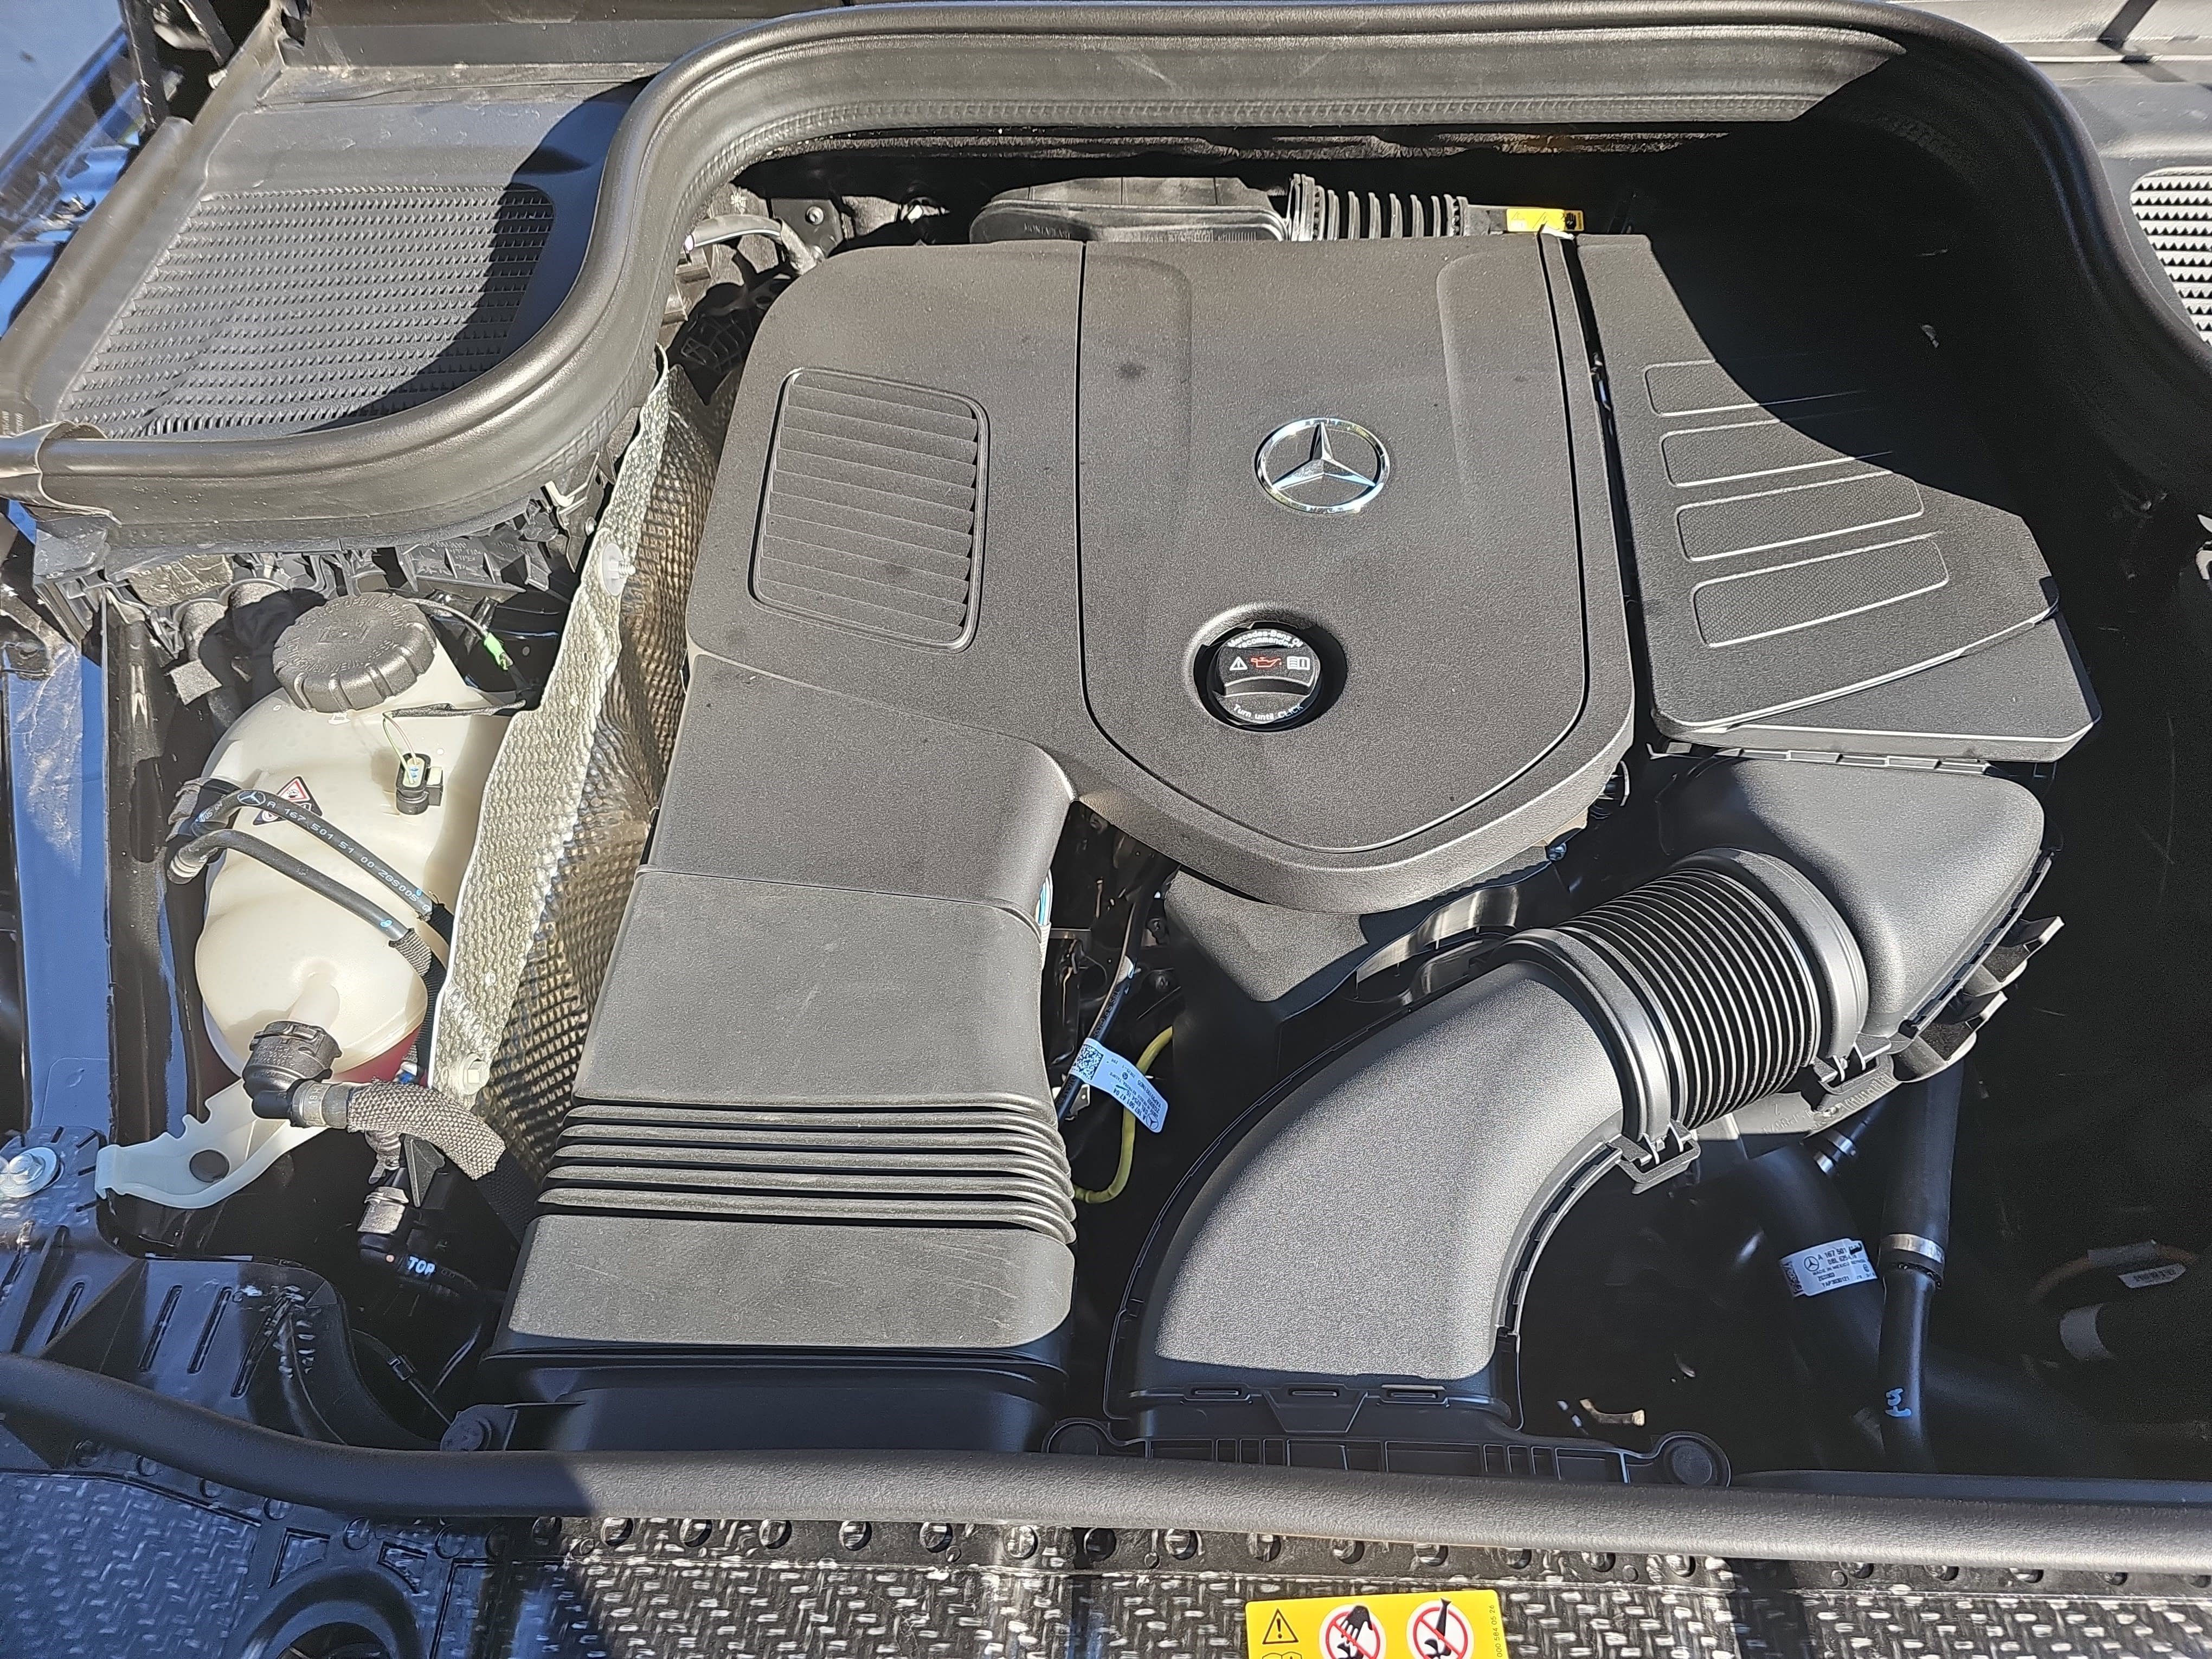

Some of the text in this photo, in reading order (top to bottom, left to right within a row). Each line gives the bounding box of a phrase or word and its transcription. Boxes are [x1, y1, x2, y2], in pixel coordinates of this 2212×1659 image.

[1227, 629, 1292, 647] Mercedes-Benz
[1233, 704, 1252, 717] Turn
[1277, 703, 1303, 718] CLICK
[284, 808, 306, 821] 167
[311, 823, 334, 840] 501
[338, 841, 355, 853] 51
[1113, 1088, 1120, 1096] 04
[1127, 1099, 1135, 1109] 501
[1824, 1250, 1835, 1258] 167
[409, 1256, 435, 1275] TOP
[1488, 1605, 1495, 1613] 26
[1490, 1616, 1497, 1625] 05
[1495, 1643, 1503, 1657] 000
